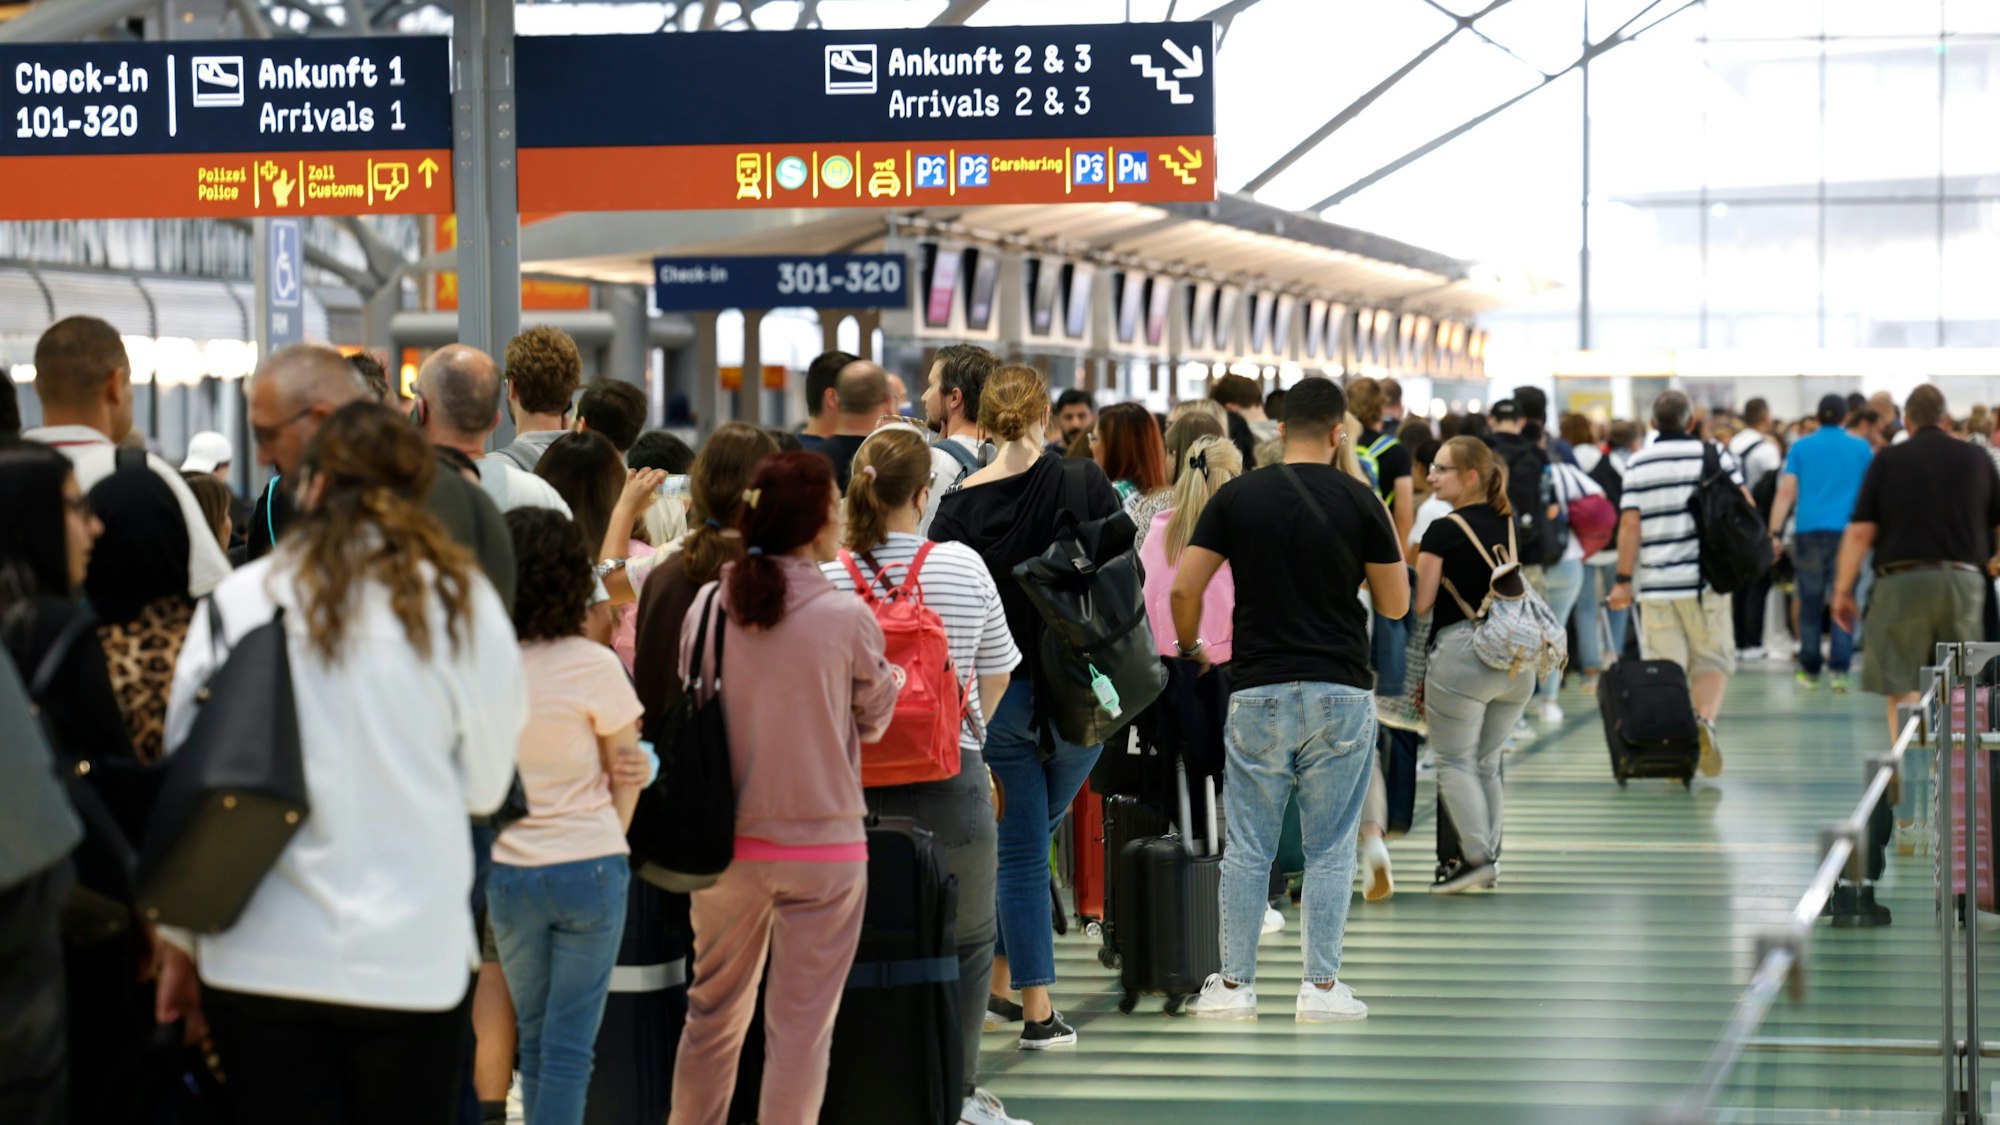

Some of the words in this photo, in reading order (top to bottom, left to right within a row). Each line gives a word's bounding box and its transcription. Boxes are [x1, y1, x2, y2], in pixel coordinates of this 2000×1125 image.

[258, 56, 378, 89] Ankunft
[388, 55, 406, 86] 1
[888, 46, 1004, 76] Ankunft
[1014, 45, 1032, 74] 2
[1043, 44, 1064, 74] &
[1074, 43, 1092, 73] 3
[15, 61, 149, 95] Check-in
[259, 100, 375, 133] Arrivals
[390, 100, 406, 131] 1
[888, 88, 1000, 118] Arrivals
[1015, 87, 1033, 116] 2
[1043, 86, 1065, 115] &
[1074, 86, 1091, 115] 3
[16, 104, 138, 138] 101-320
[198, 167, 247, 183] Polizei
[308, 165, 336, 181] Zoll
[991, 157, 1063, 175] Carsharing
[198, 183, 240, 201] Police
[308, 181, 364, 199] Customs
[659, 265, 728, 283] Check-in
[777, 262, 901, 294] 301-320
